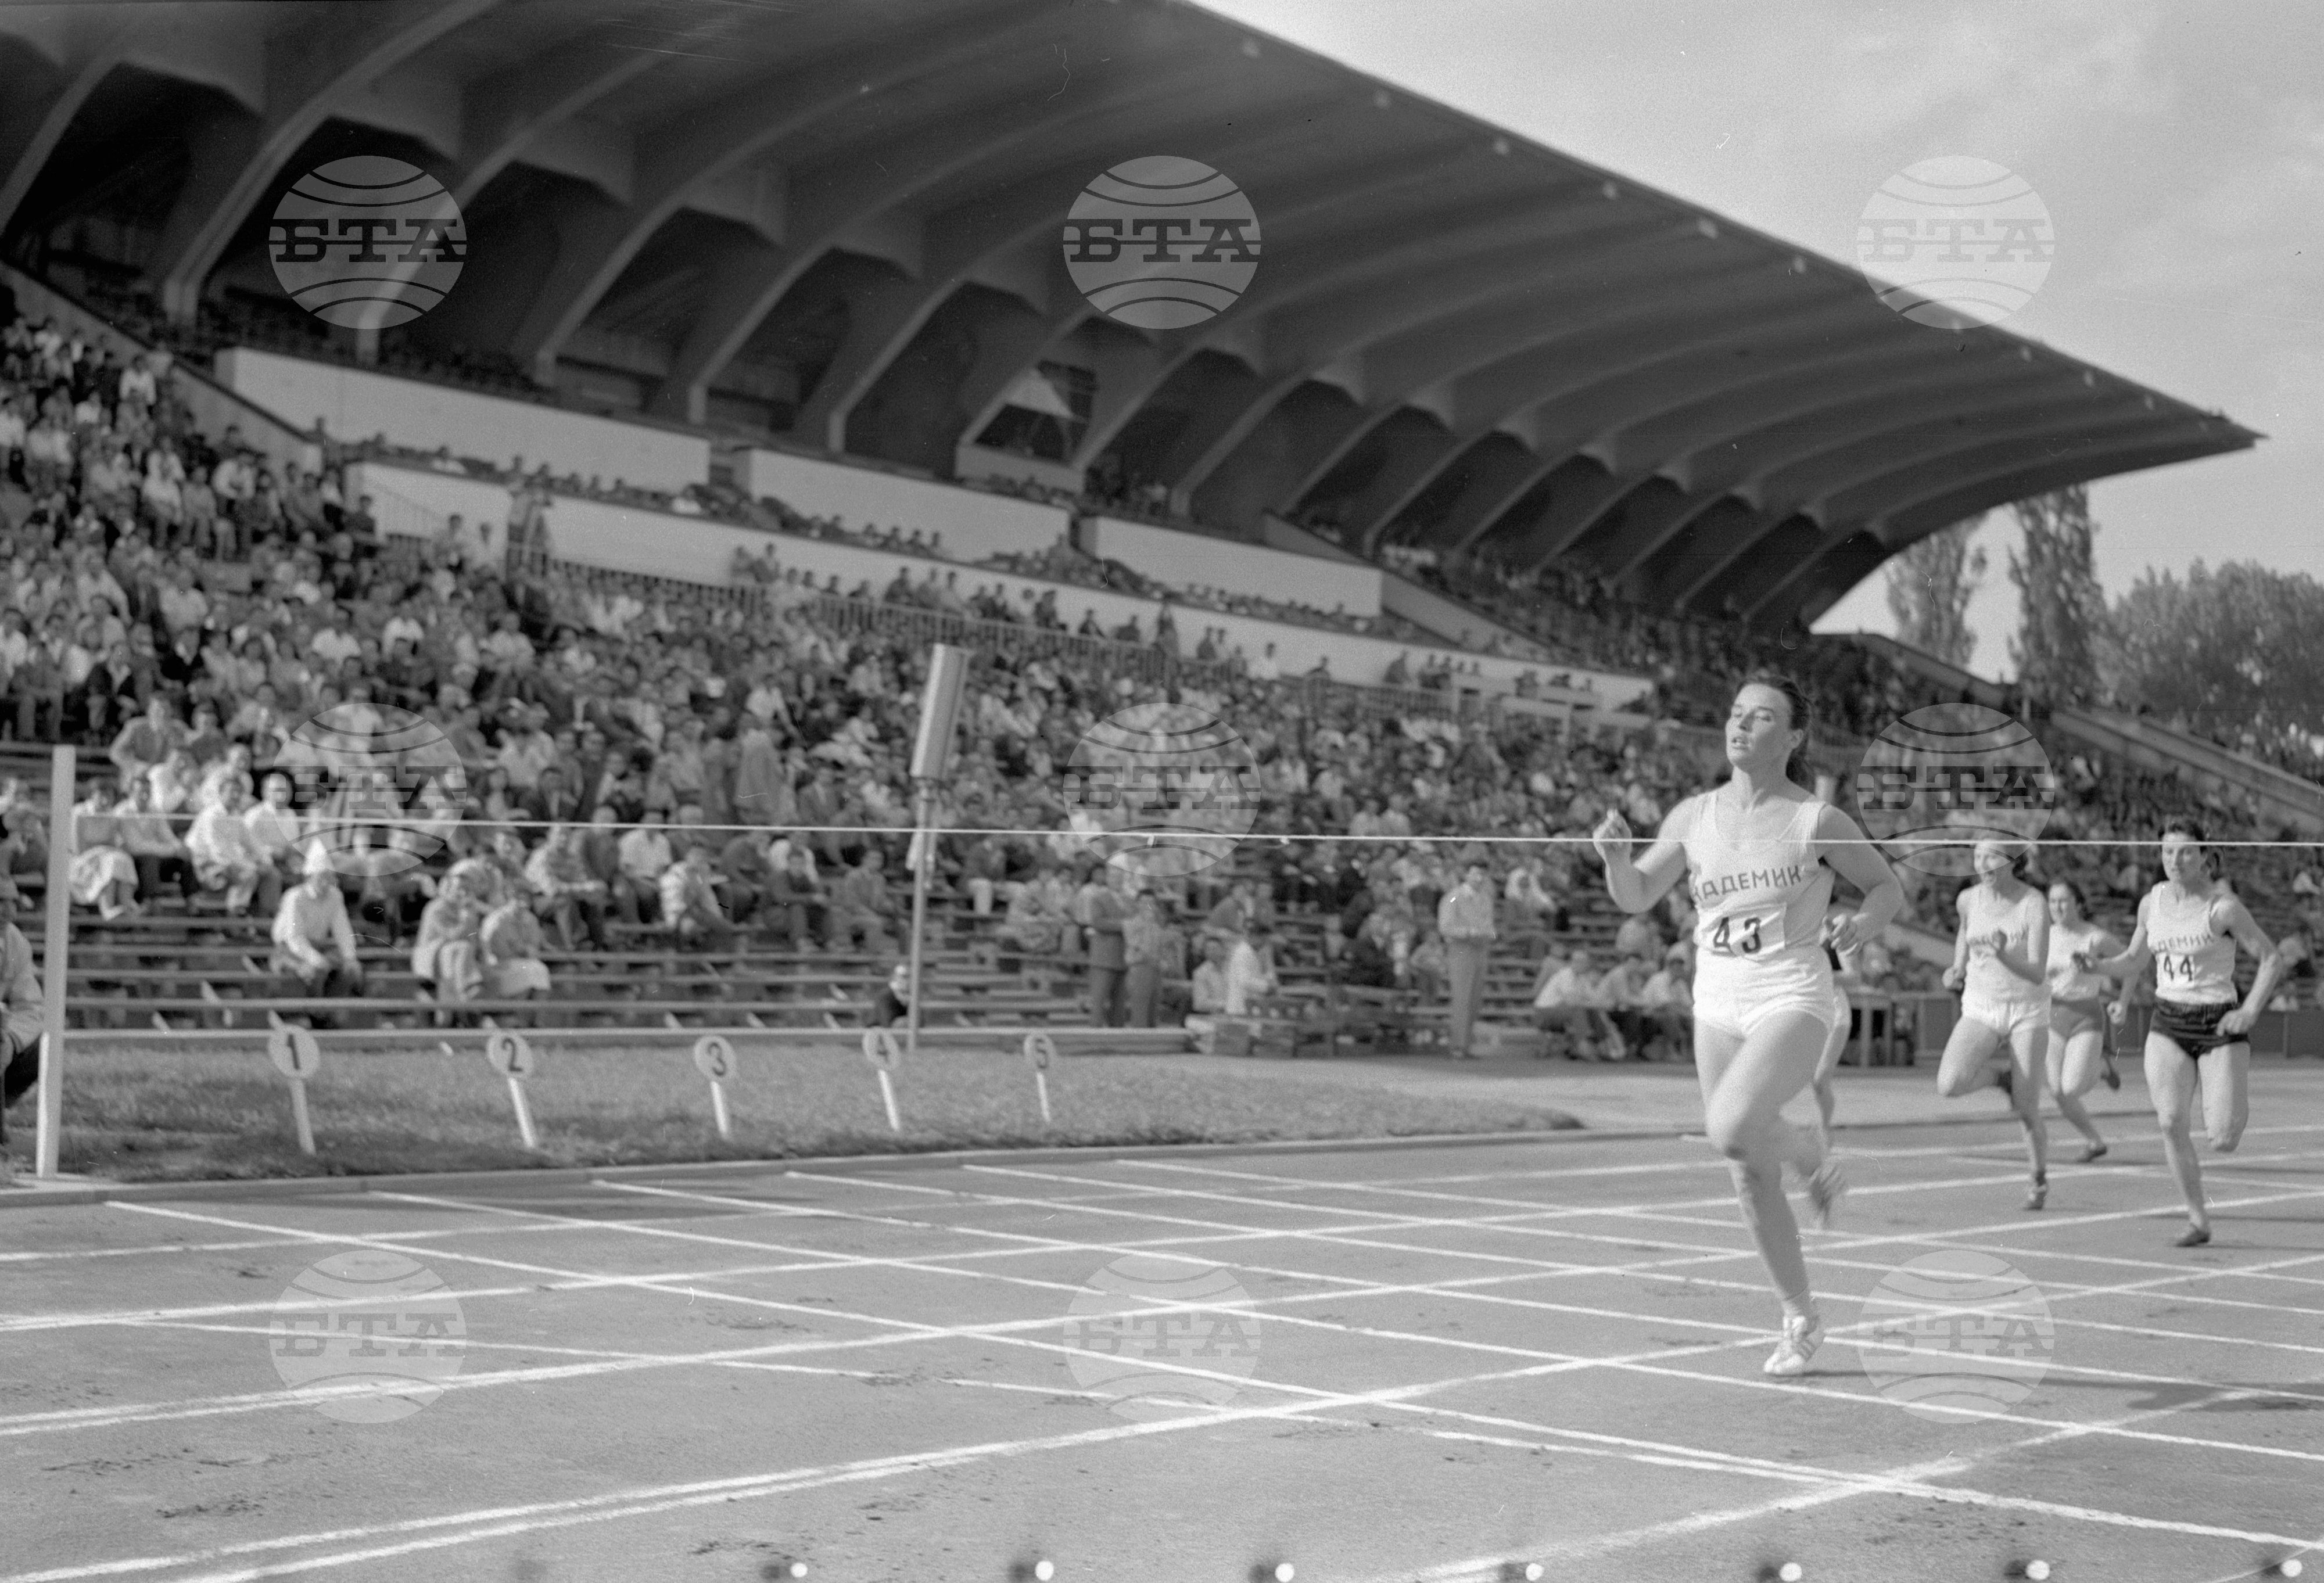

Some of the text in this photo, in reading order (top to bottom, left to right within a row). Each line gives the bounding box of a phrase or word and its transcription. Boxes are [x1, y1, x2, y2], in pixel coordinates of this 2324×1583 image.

[1713, 916, 1762, 954] 43
[2164, 955, 2193, 982] 44
[286, 1033, 300, 1071] 1
[501, 1038, 524, 1072] 2
[707, 1042, 726, 1077] 3
[876, 1034, 890, 1063] 4
[1035, 1038, 1049, 1069] 5
